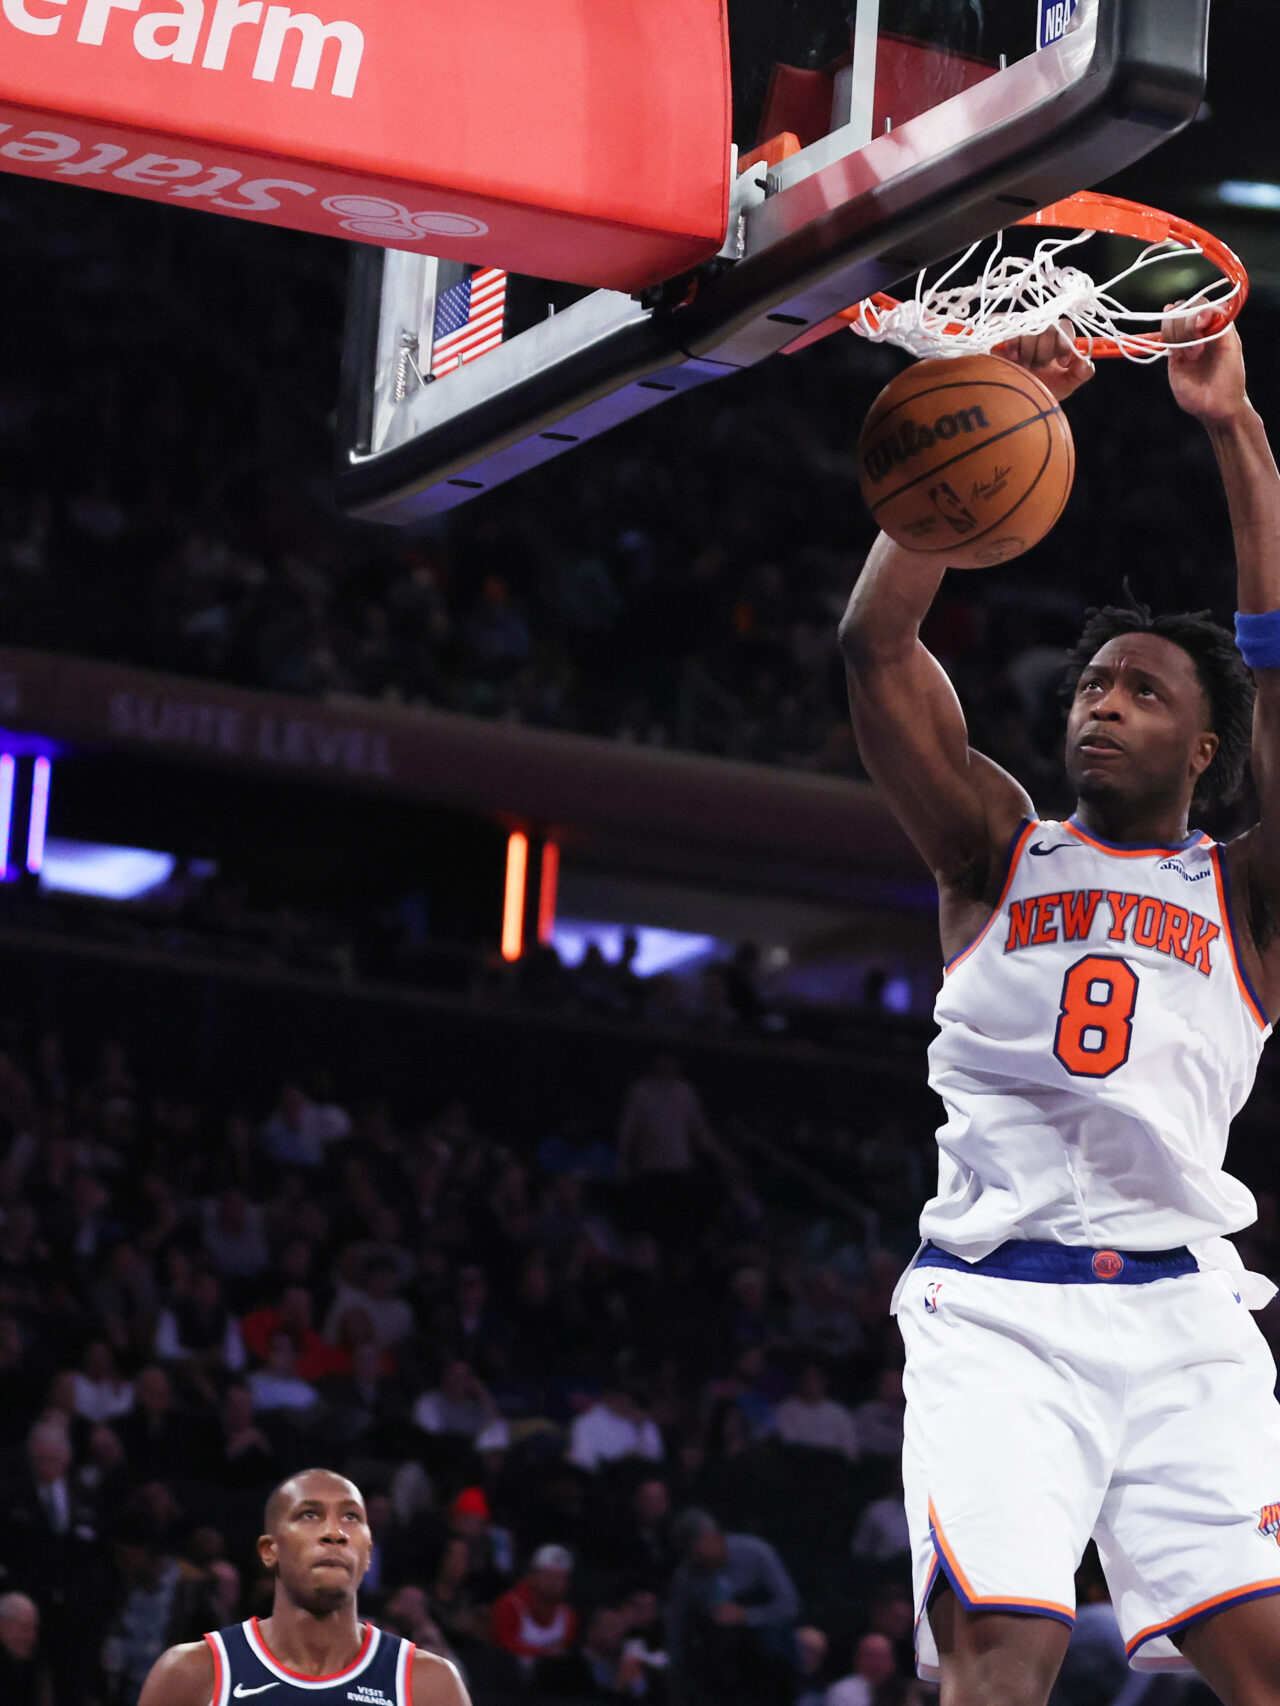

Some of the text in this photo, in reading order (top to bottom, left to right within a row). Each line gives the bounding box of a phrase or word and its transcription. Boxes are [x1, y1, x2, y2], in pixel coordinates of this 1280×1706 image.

[1045, 0, 1071, 43] NBA
[863, 405, 990, 485] Wilson
[1003, 889, 1221, 979] NEW YORK
[1053, 954, 1140, 1079] 8
[347, 1692, 395, 1706] RWANDA
[356, 1685, 384, 1698] VISIT
